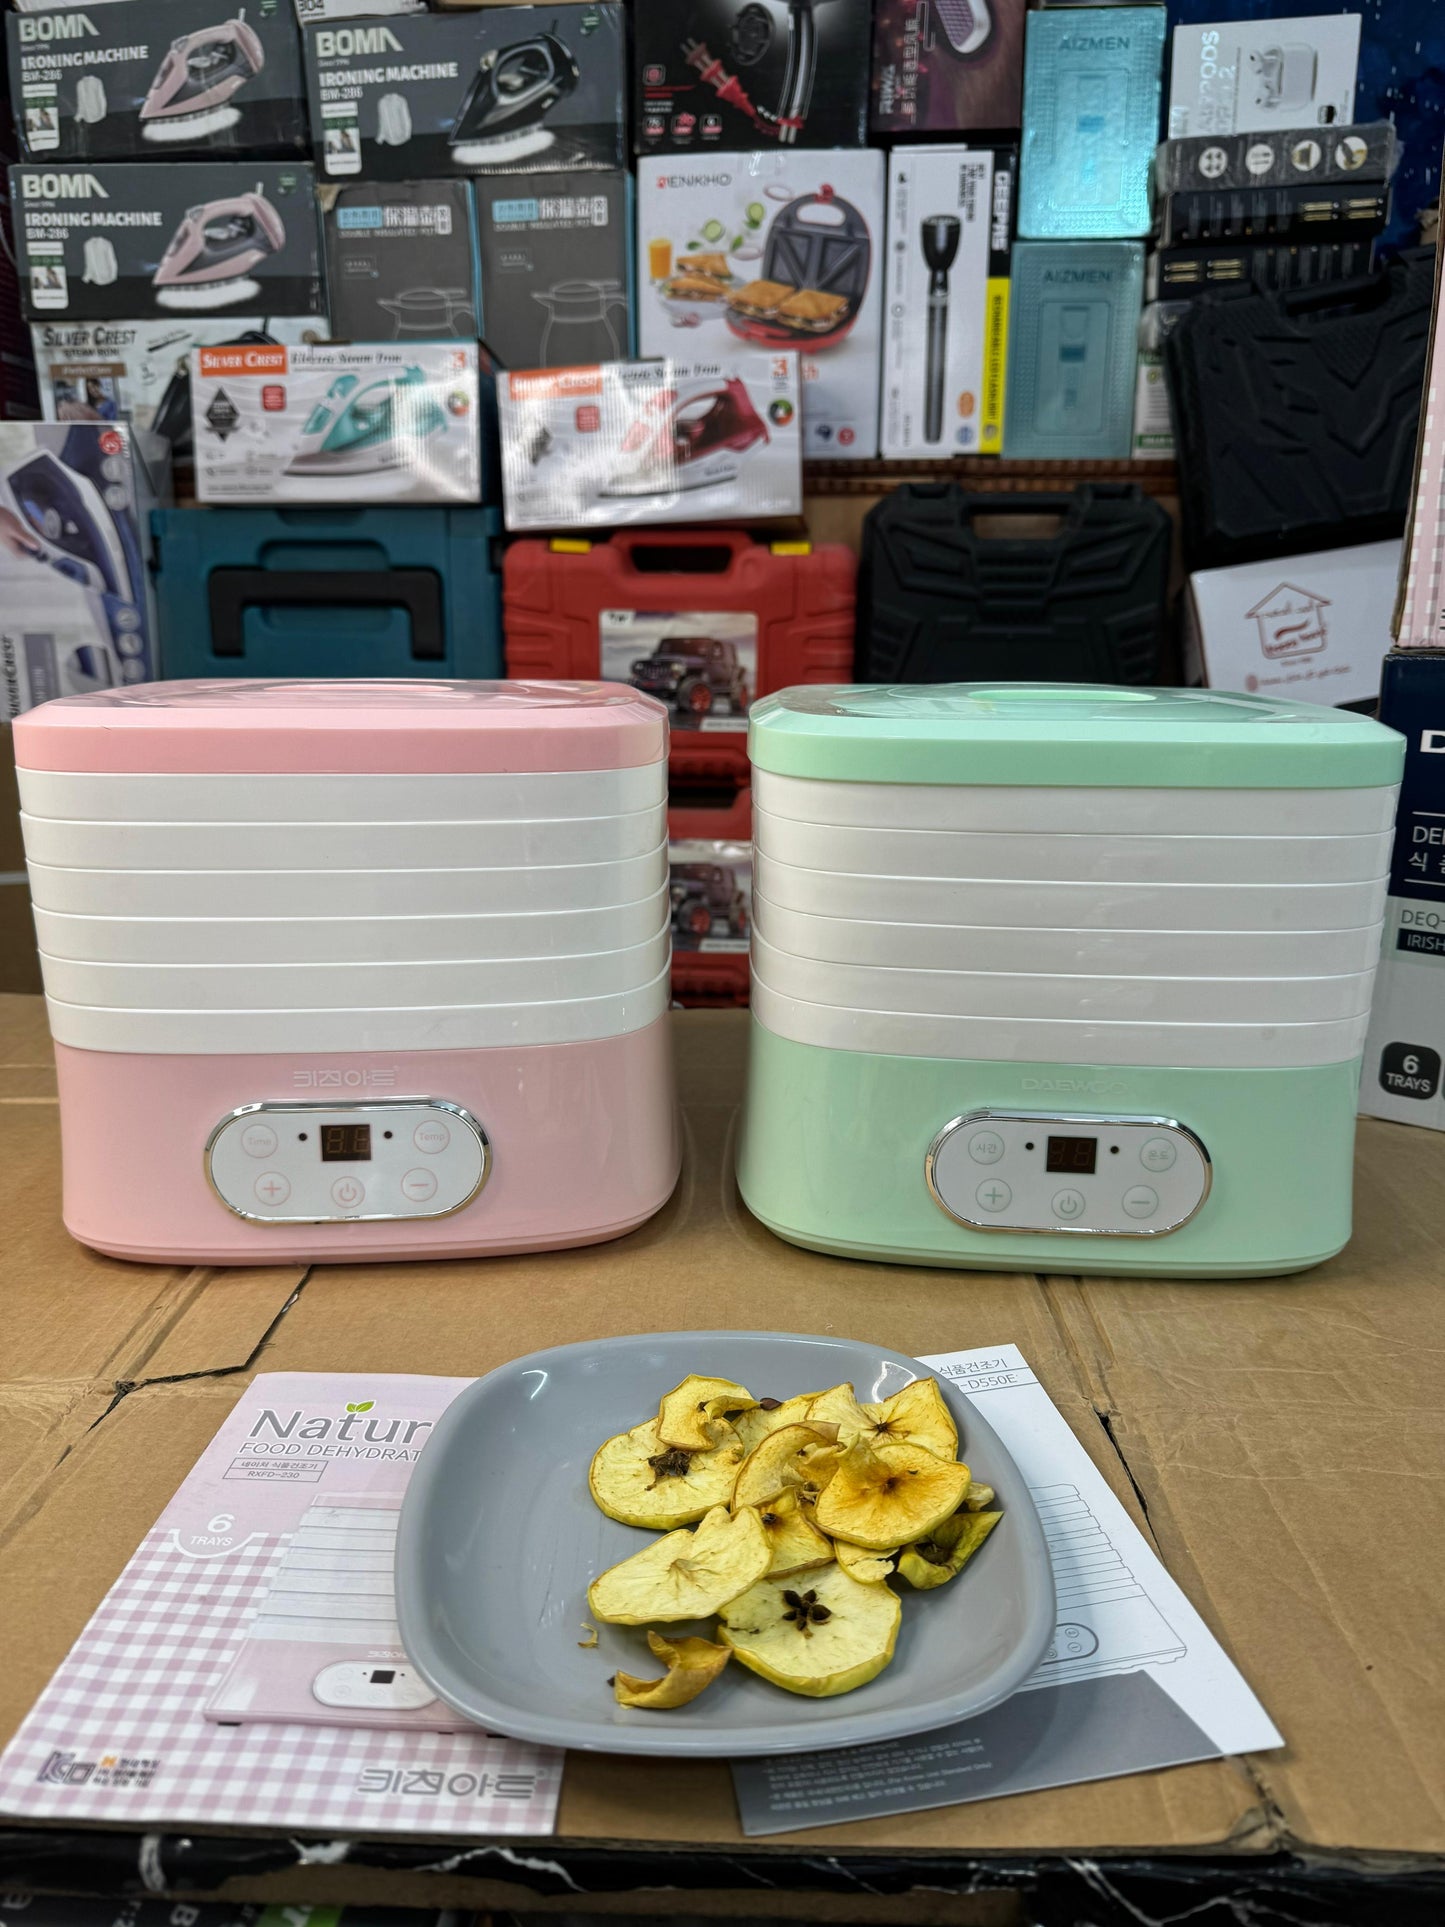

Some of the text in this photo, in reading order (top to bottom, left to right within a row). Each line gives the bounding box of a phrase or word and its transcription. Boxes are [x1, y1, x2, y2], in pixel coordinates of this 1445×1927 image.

[18, 13, 100, 42] BOMA
[316, 27, 404, 57] BOMA
[1058, 35, 1131, 52] AIZMEN
[21, 45, 149, 70] IRONING MACHINE
[22, 69, 62, 82] BM-286
[319, 62, 459, 88] IRONING MACHINE
[21, 173, 110, 199] BOMA
[24, 211, 163, 227] IRONING MACHINE
[26, 227, 69, 240] BM-286
[1043, 269, 1113, 284] AIZMEN
[43, 326, 137, 347] SILVER CREST
[202, 351, 284, 369] SILVER CREST
[1403, 1054, 1420, 1074] 6
[293, 1069, 396, 1088] 키친아트
[1385, 1072, 1431, 1093] TRAYS
[247, 1136, 272, 1147] Time
[418, 1131, 446, 1143] Temp
[976, 1142, 998, 1155] 시간
[940, 1358, 1008, 1376] 식품건조기
[239, 1442, 302, 1456] FOOD
[241, 1461, 319, 1470] 네이처 식품건조기
[247, 1470, 300, 1479] RXFD-230
[207, 1512, 236, 1533] 6
[190, 1535, 233, 1547] TRAYS
[358, 1767, 537, 1799] 키친아트
